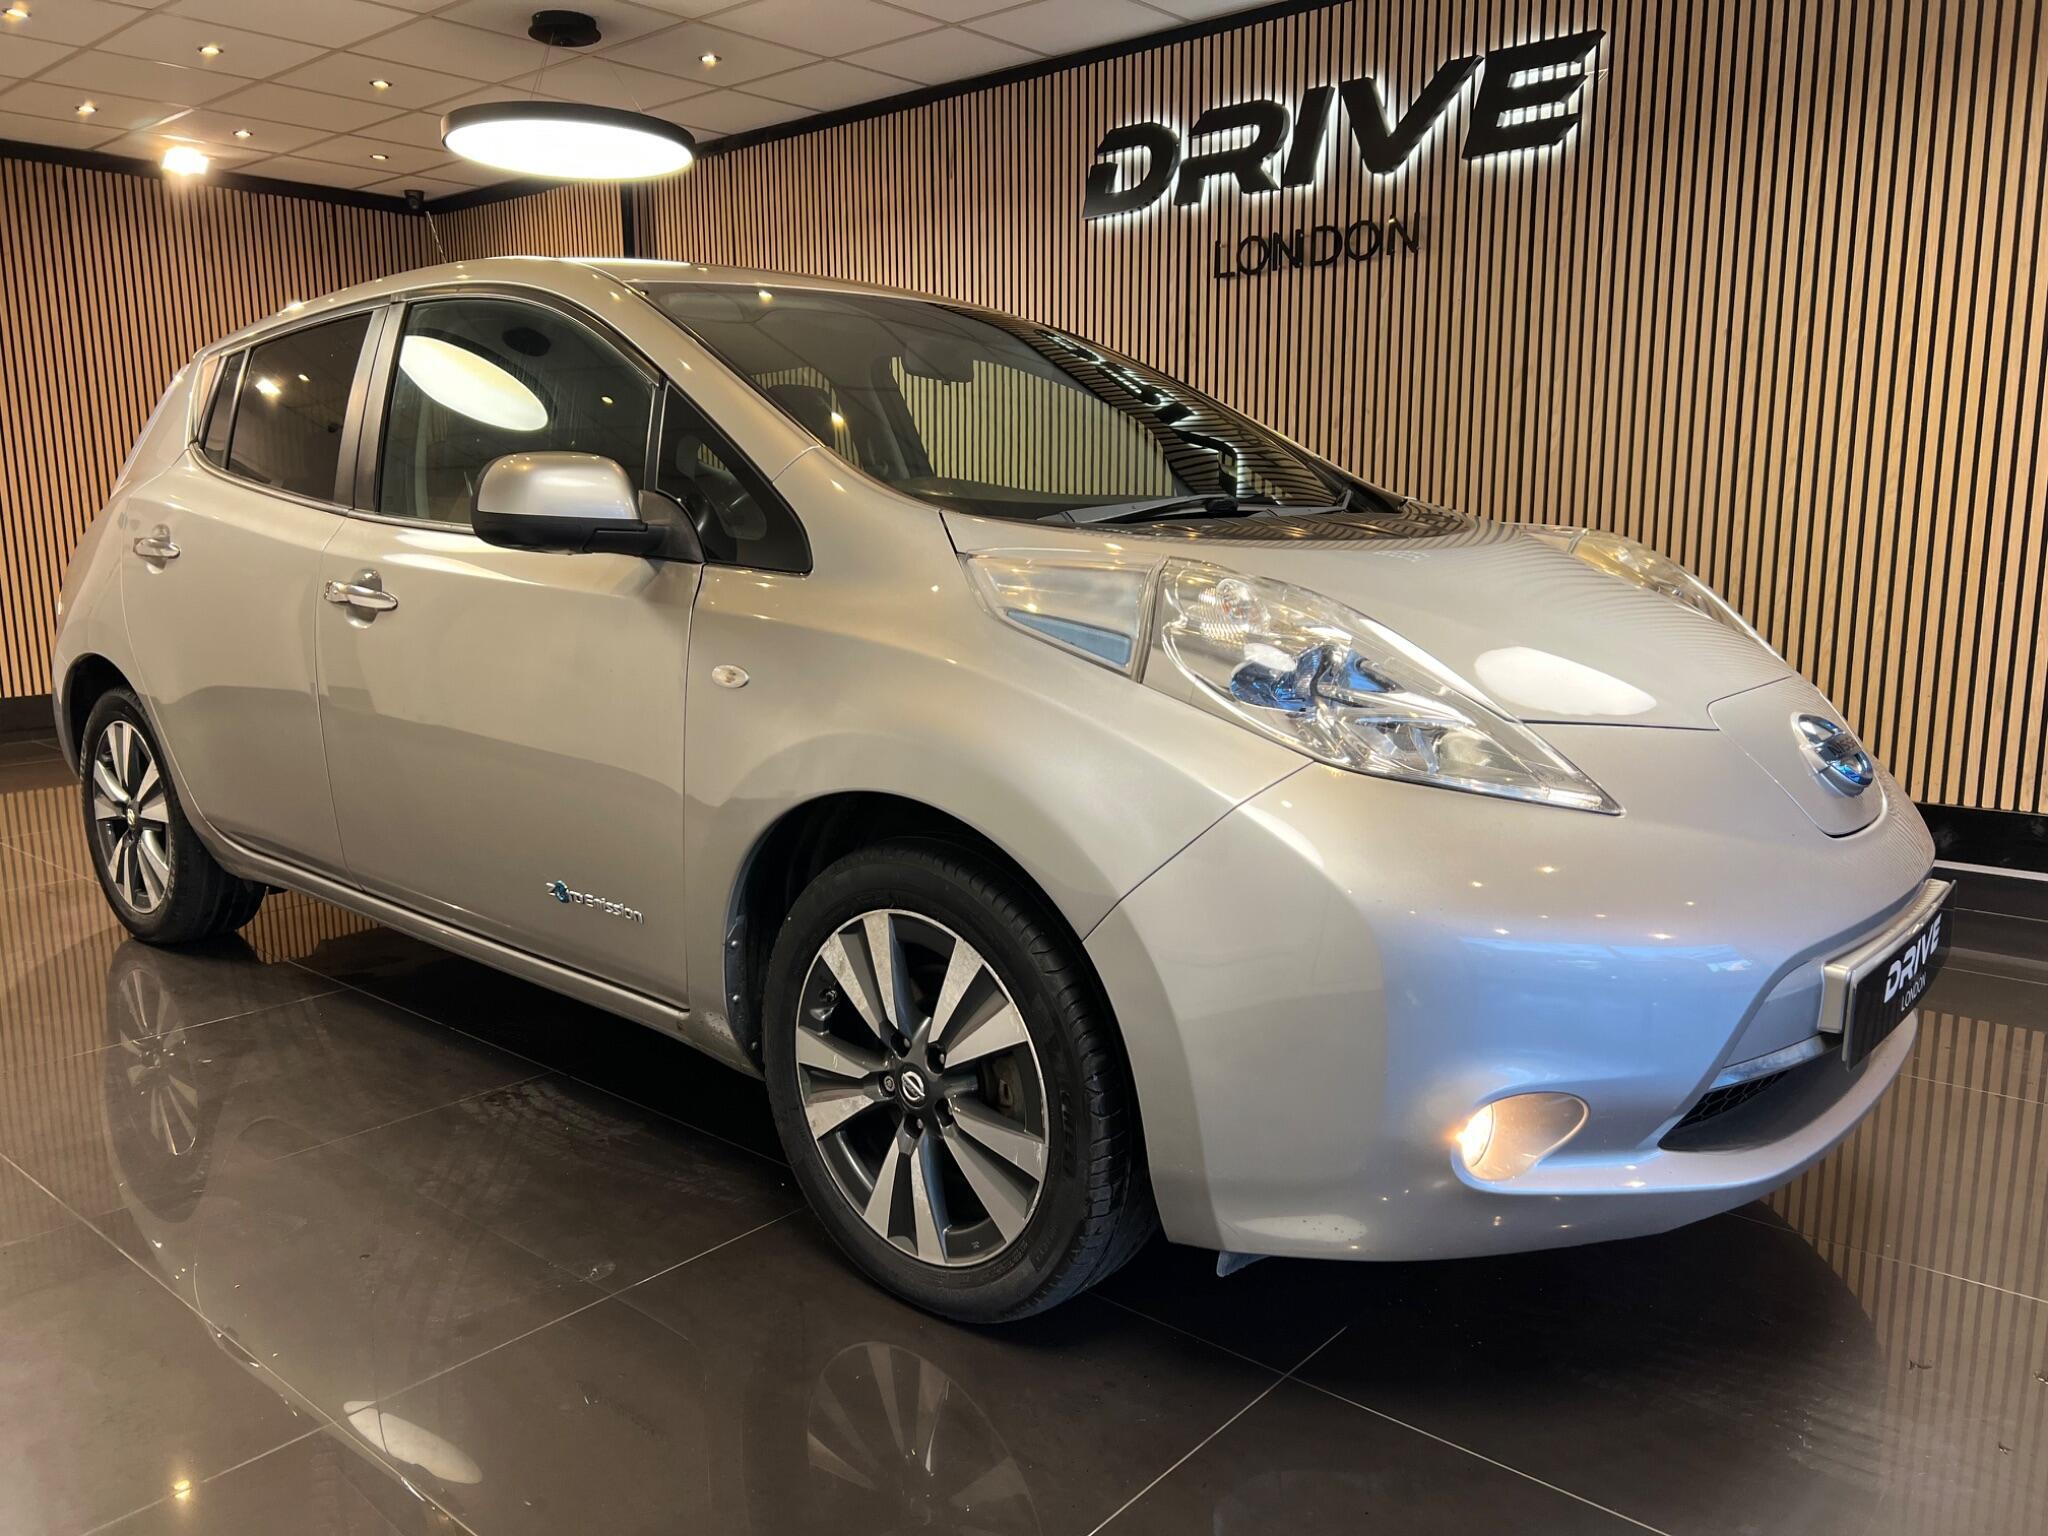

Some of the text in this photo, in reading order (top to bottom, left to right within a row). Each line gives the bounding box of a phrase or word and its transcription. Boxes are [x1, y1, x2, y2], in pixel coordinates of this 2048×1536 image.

[1082, 29, 1607, 219] DRIVE
[1213, 213, 1422, 279] LONDON
[1884, 912, 1943, 1004] DRIVE
[1901, 972, 1927, 1012] LONDON
